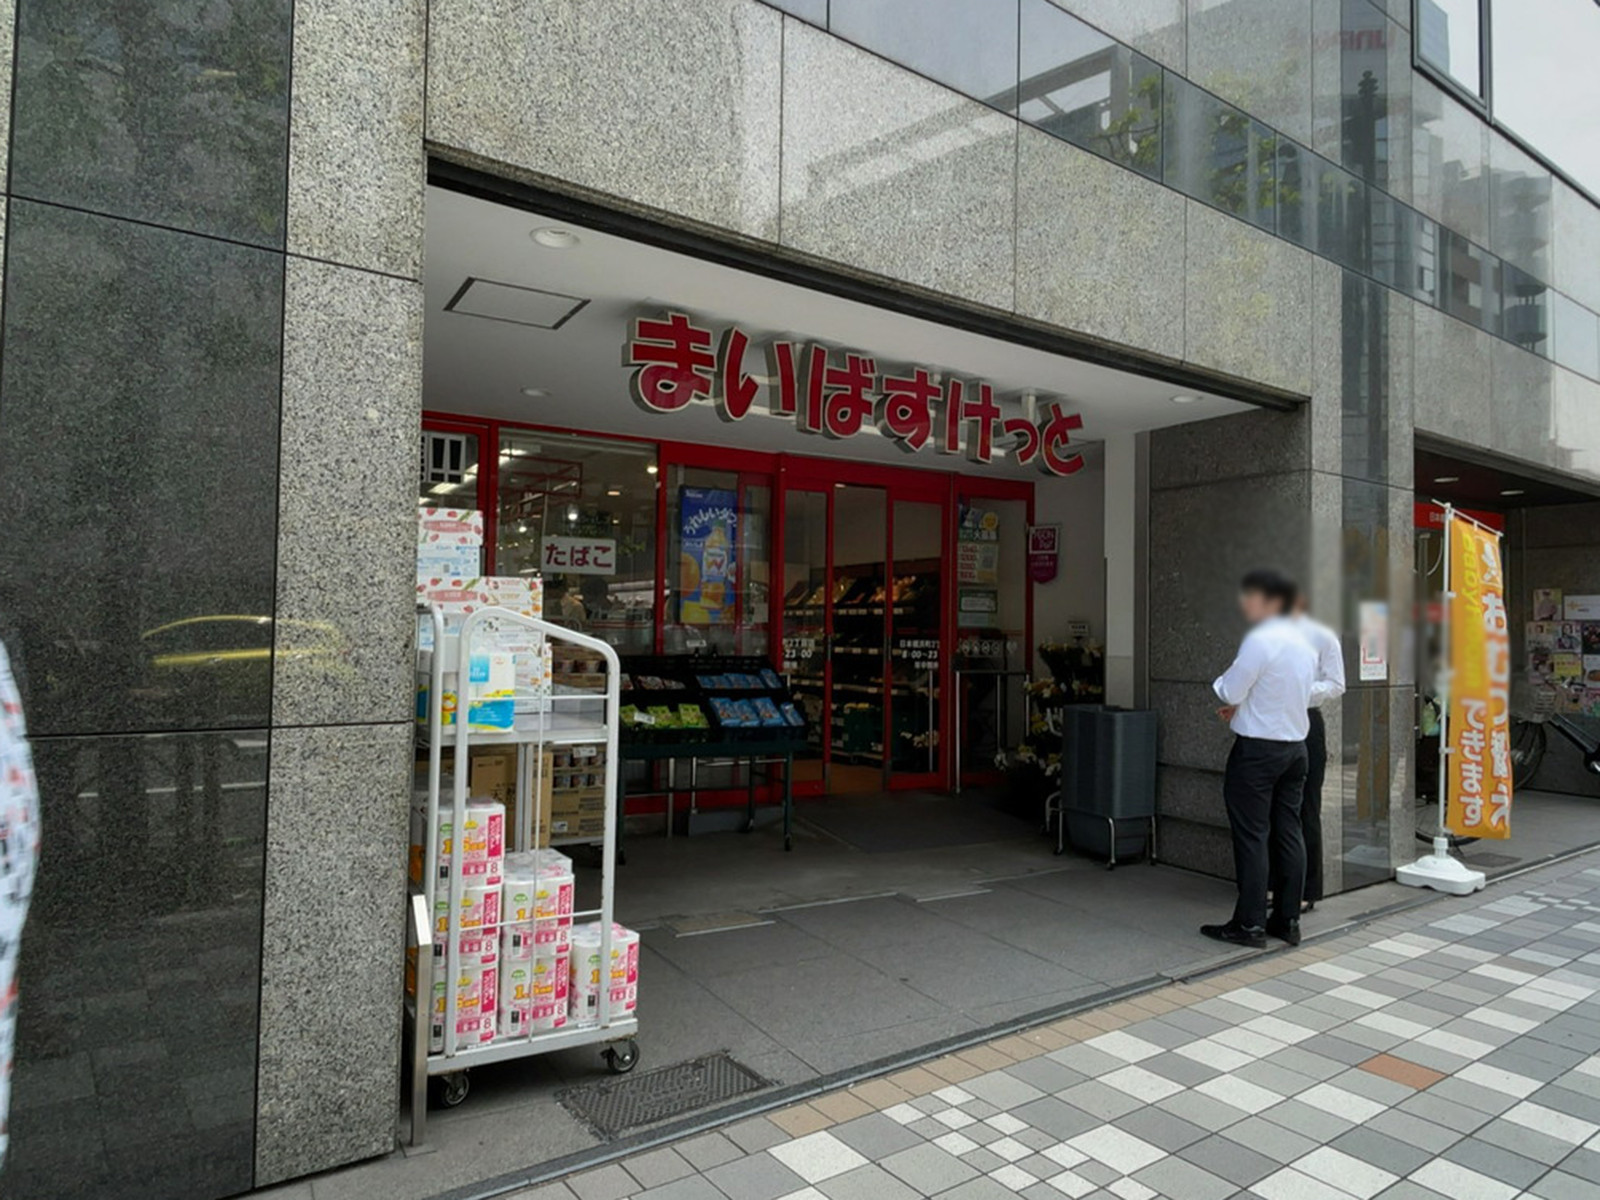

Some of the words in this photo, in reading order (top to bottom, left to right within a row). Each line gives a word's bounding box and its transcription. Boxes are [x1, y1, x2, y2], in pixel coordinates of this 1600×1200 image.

[626, 311, 1085, 478] まいばすけっと
[544, 542, 613, 569] たばこ
[1459, 698, 1487, 828] できます
